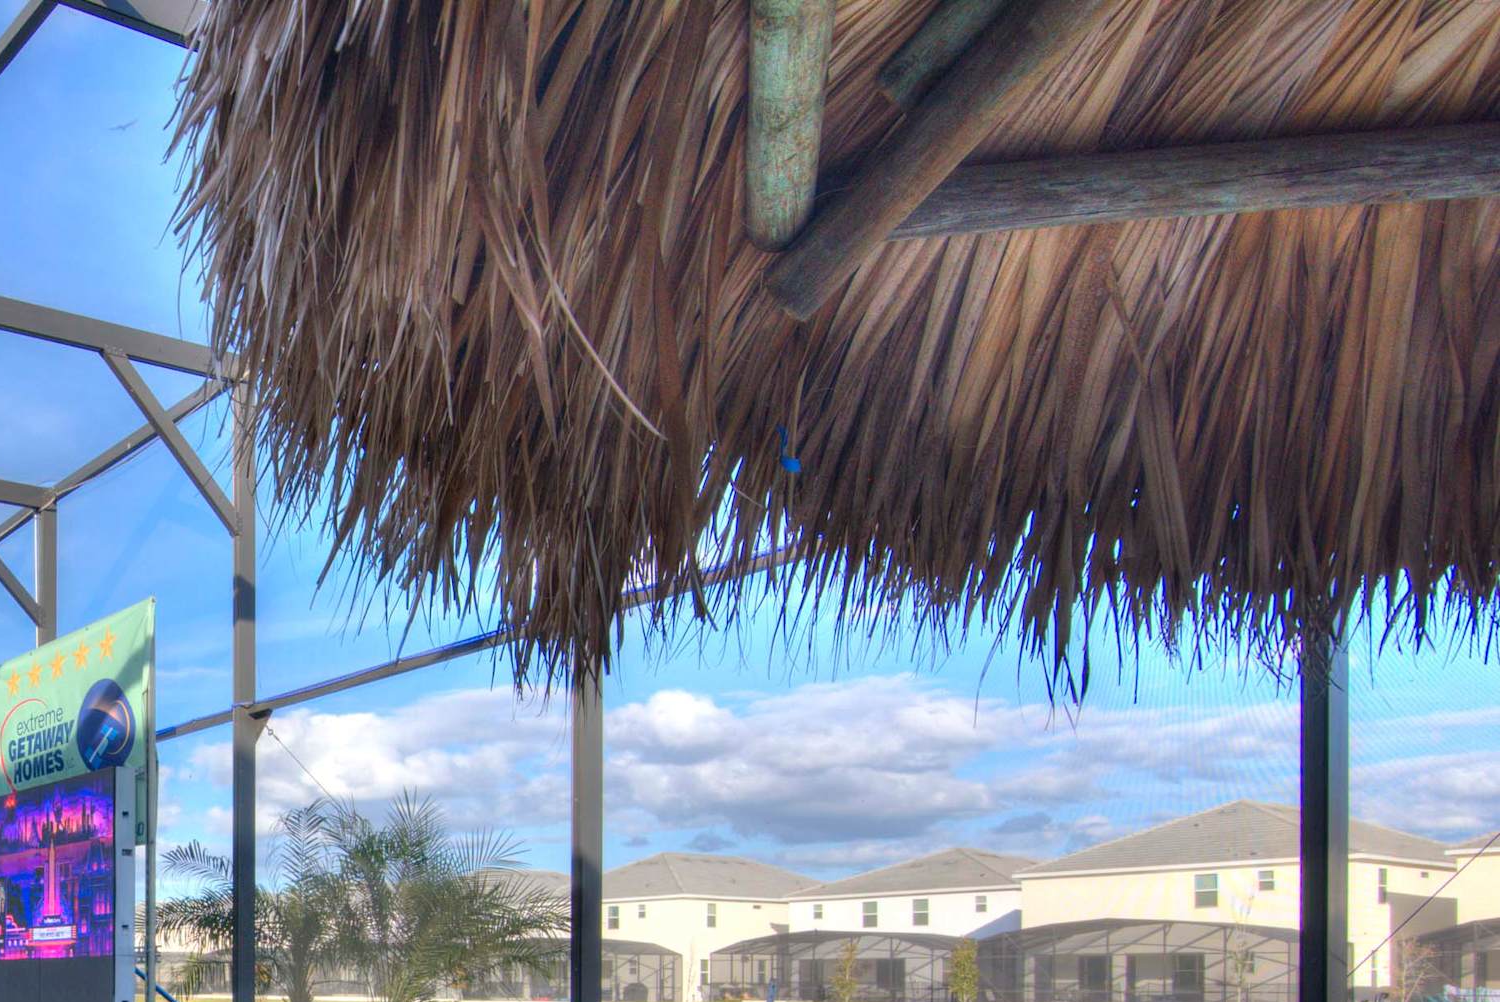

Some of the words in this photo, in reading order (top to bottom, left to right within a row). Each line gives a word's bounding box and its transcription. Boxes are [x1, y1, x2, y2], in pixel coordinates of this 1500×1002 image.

[16, 707, 63, 736] extreme
[8, 719, 75, 762] GETAWAY
[13, 749, 64, 784] HOMES
